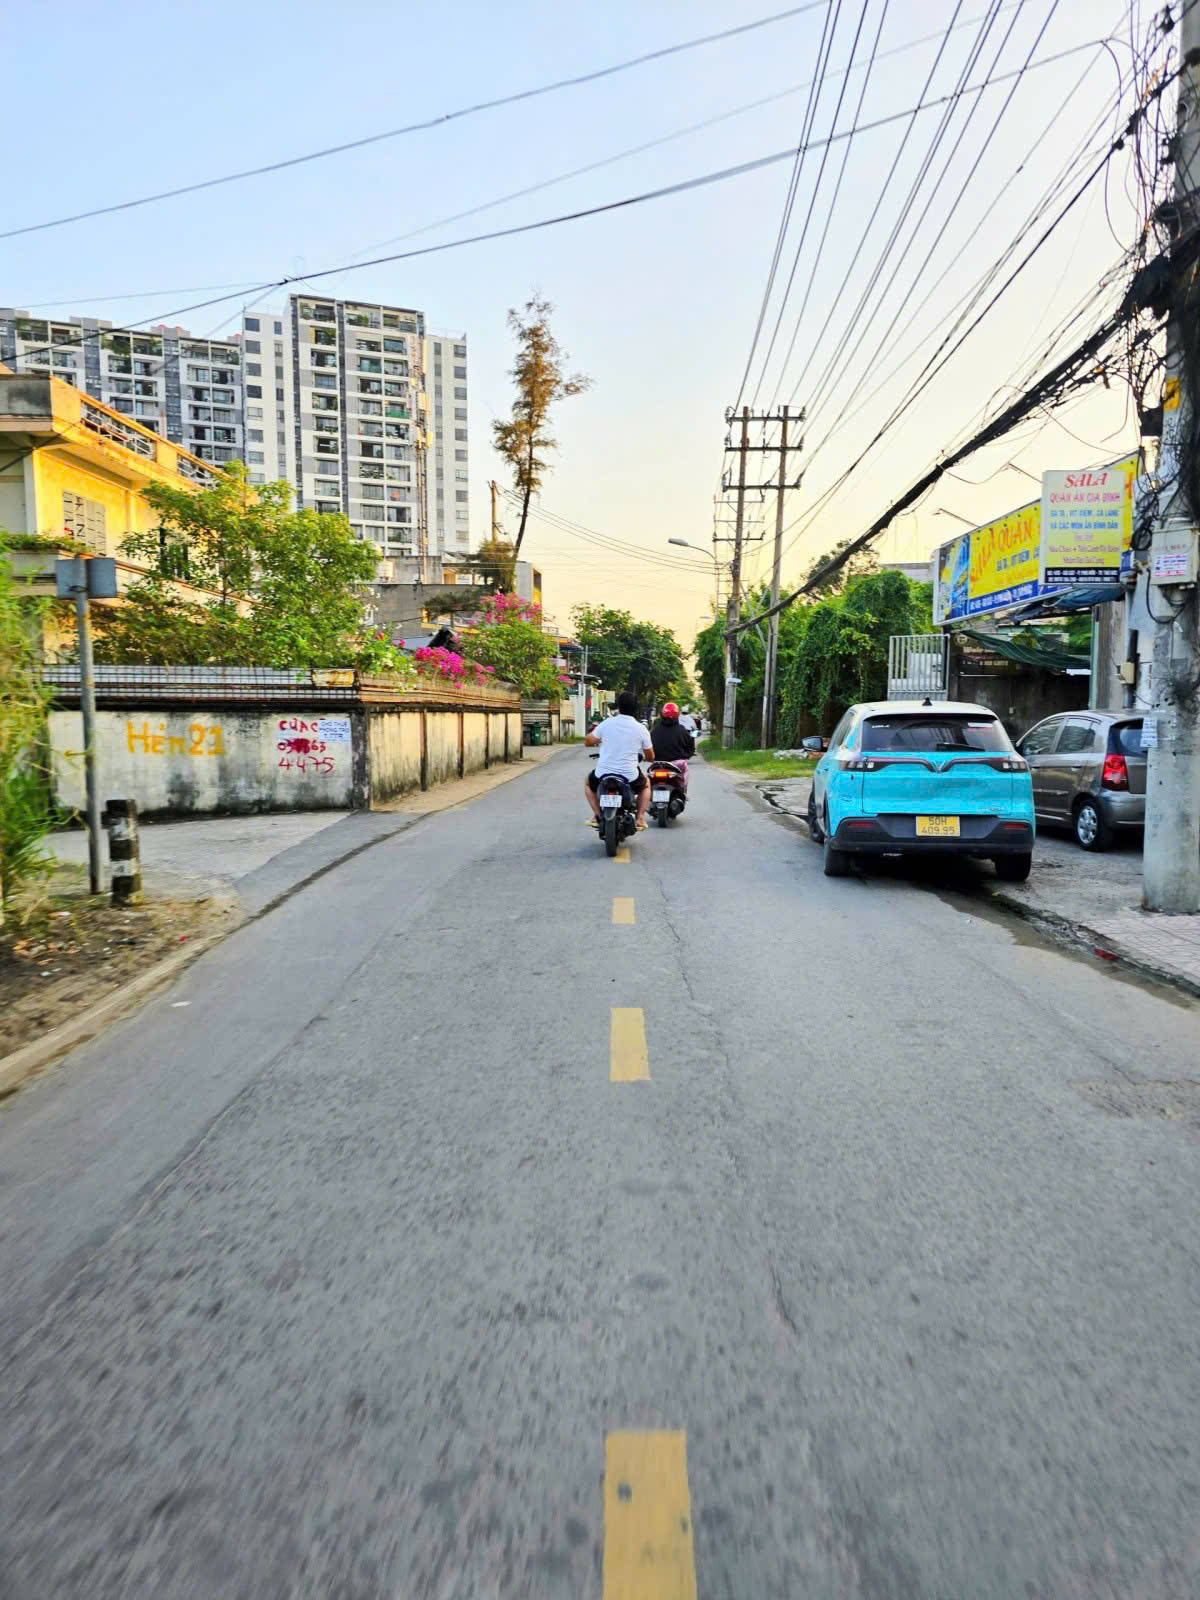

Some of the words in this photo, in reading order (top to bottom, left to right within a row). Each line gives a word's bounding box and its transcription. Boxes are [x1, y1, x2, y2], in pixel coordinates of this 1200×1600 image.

[1064, 472, 1108, 488] SALA
[188, 722, 225, 756] 21
[928, 817, 947, 826] 50H
[921, 826, 955, 835] 409.95
